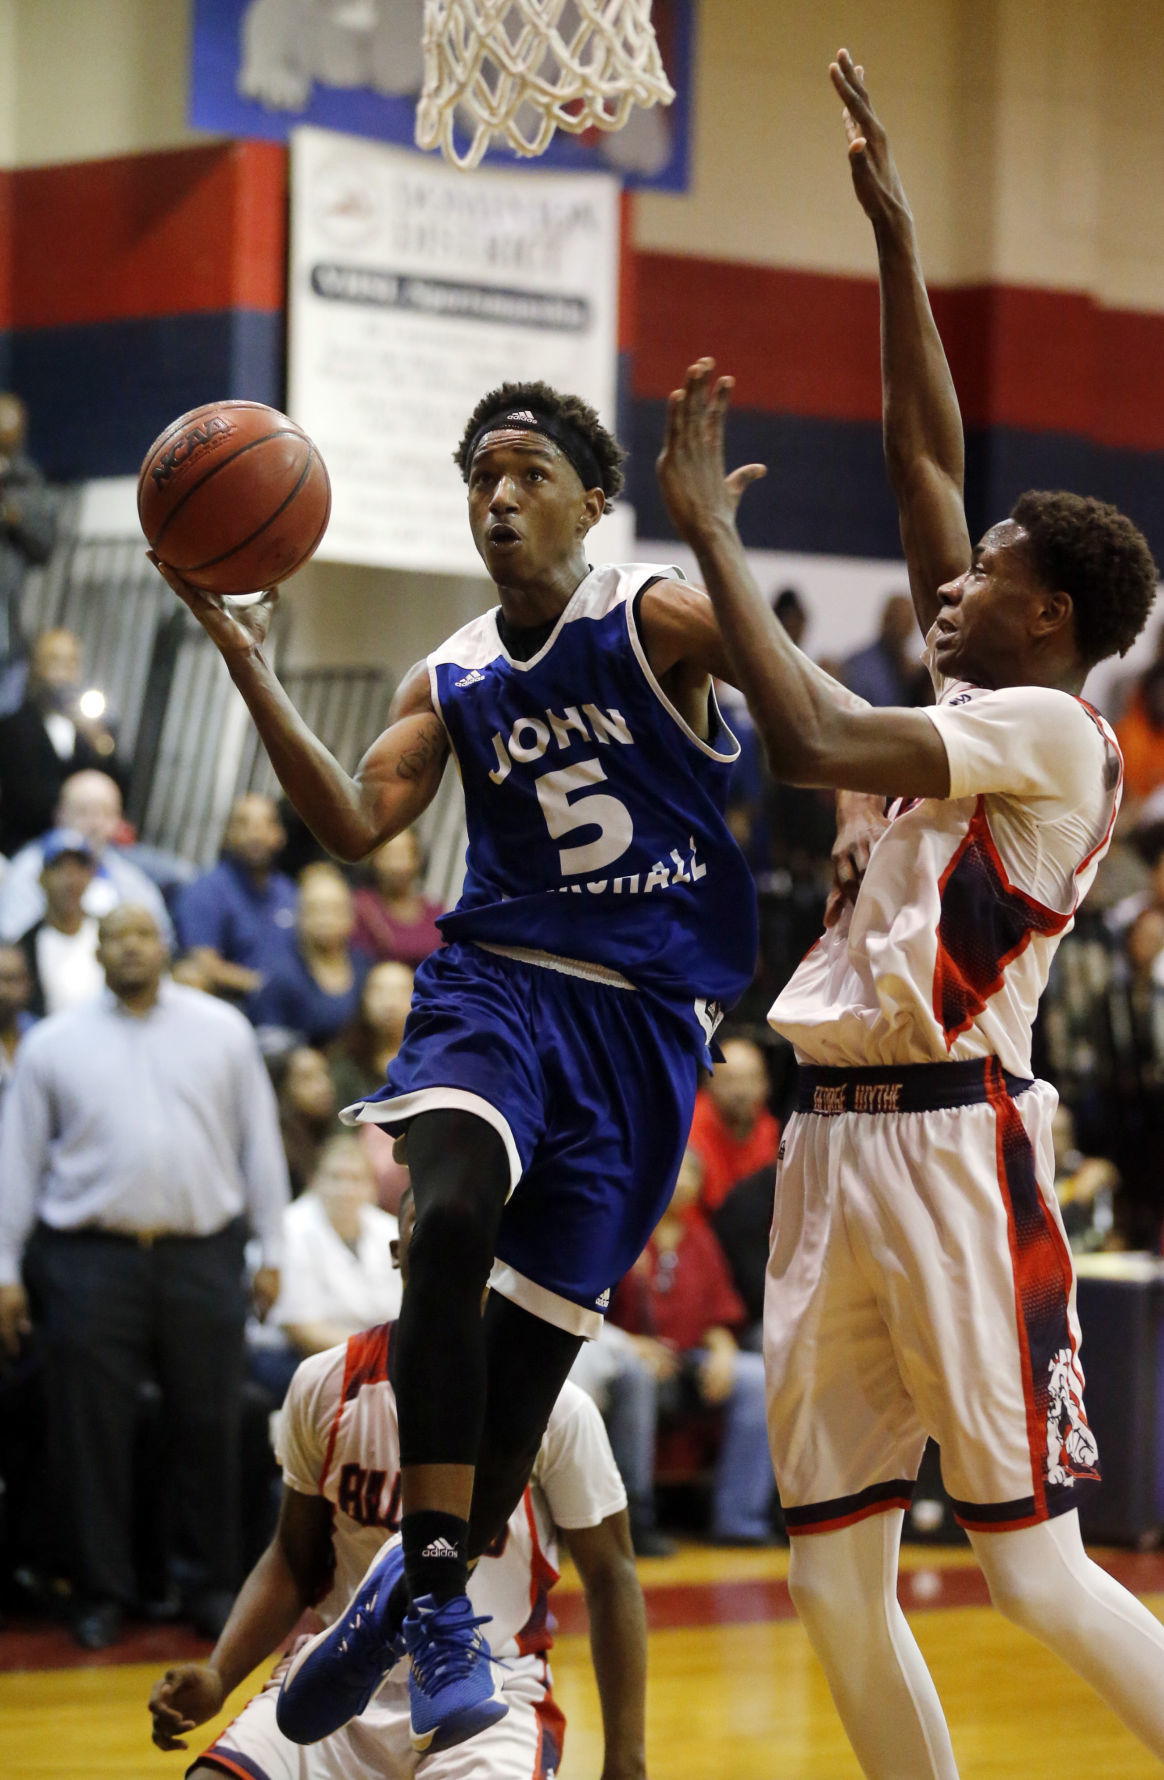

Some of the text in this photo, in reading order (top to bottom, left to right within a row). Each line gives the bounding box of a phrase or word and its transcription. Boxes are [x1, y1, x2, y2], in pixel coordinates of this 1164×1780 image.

[152, 416, 231, 491] NCAA
[488, 703, 635, 785] JOHN
[535, 757, 634, 876] 5
